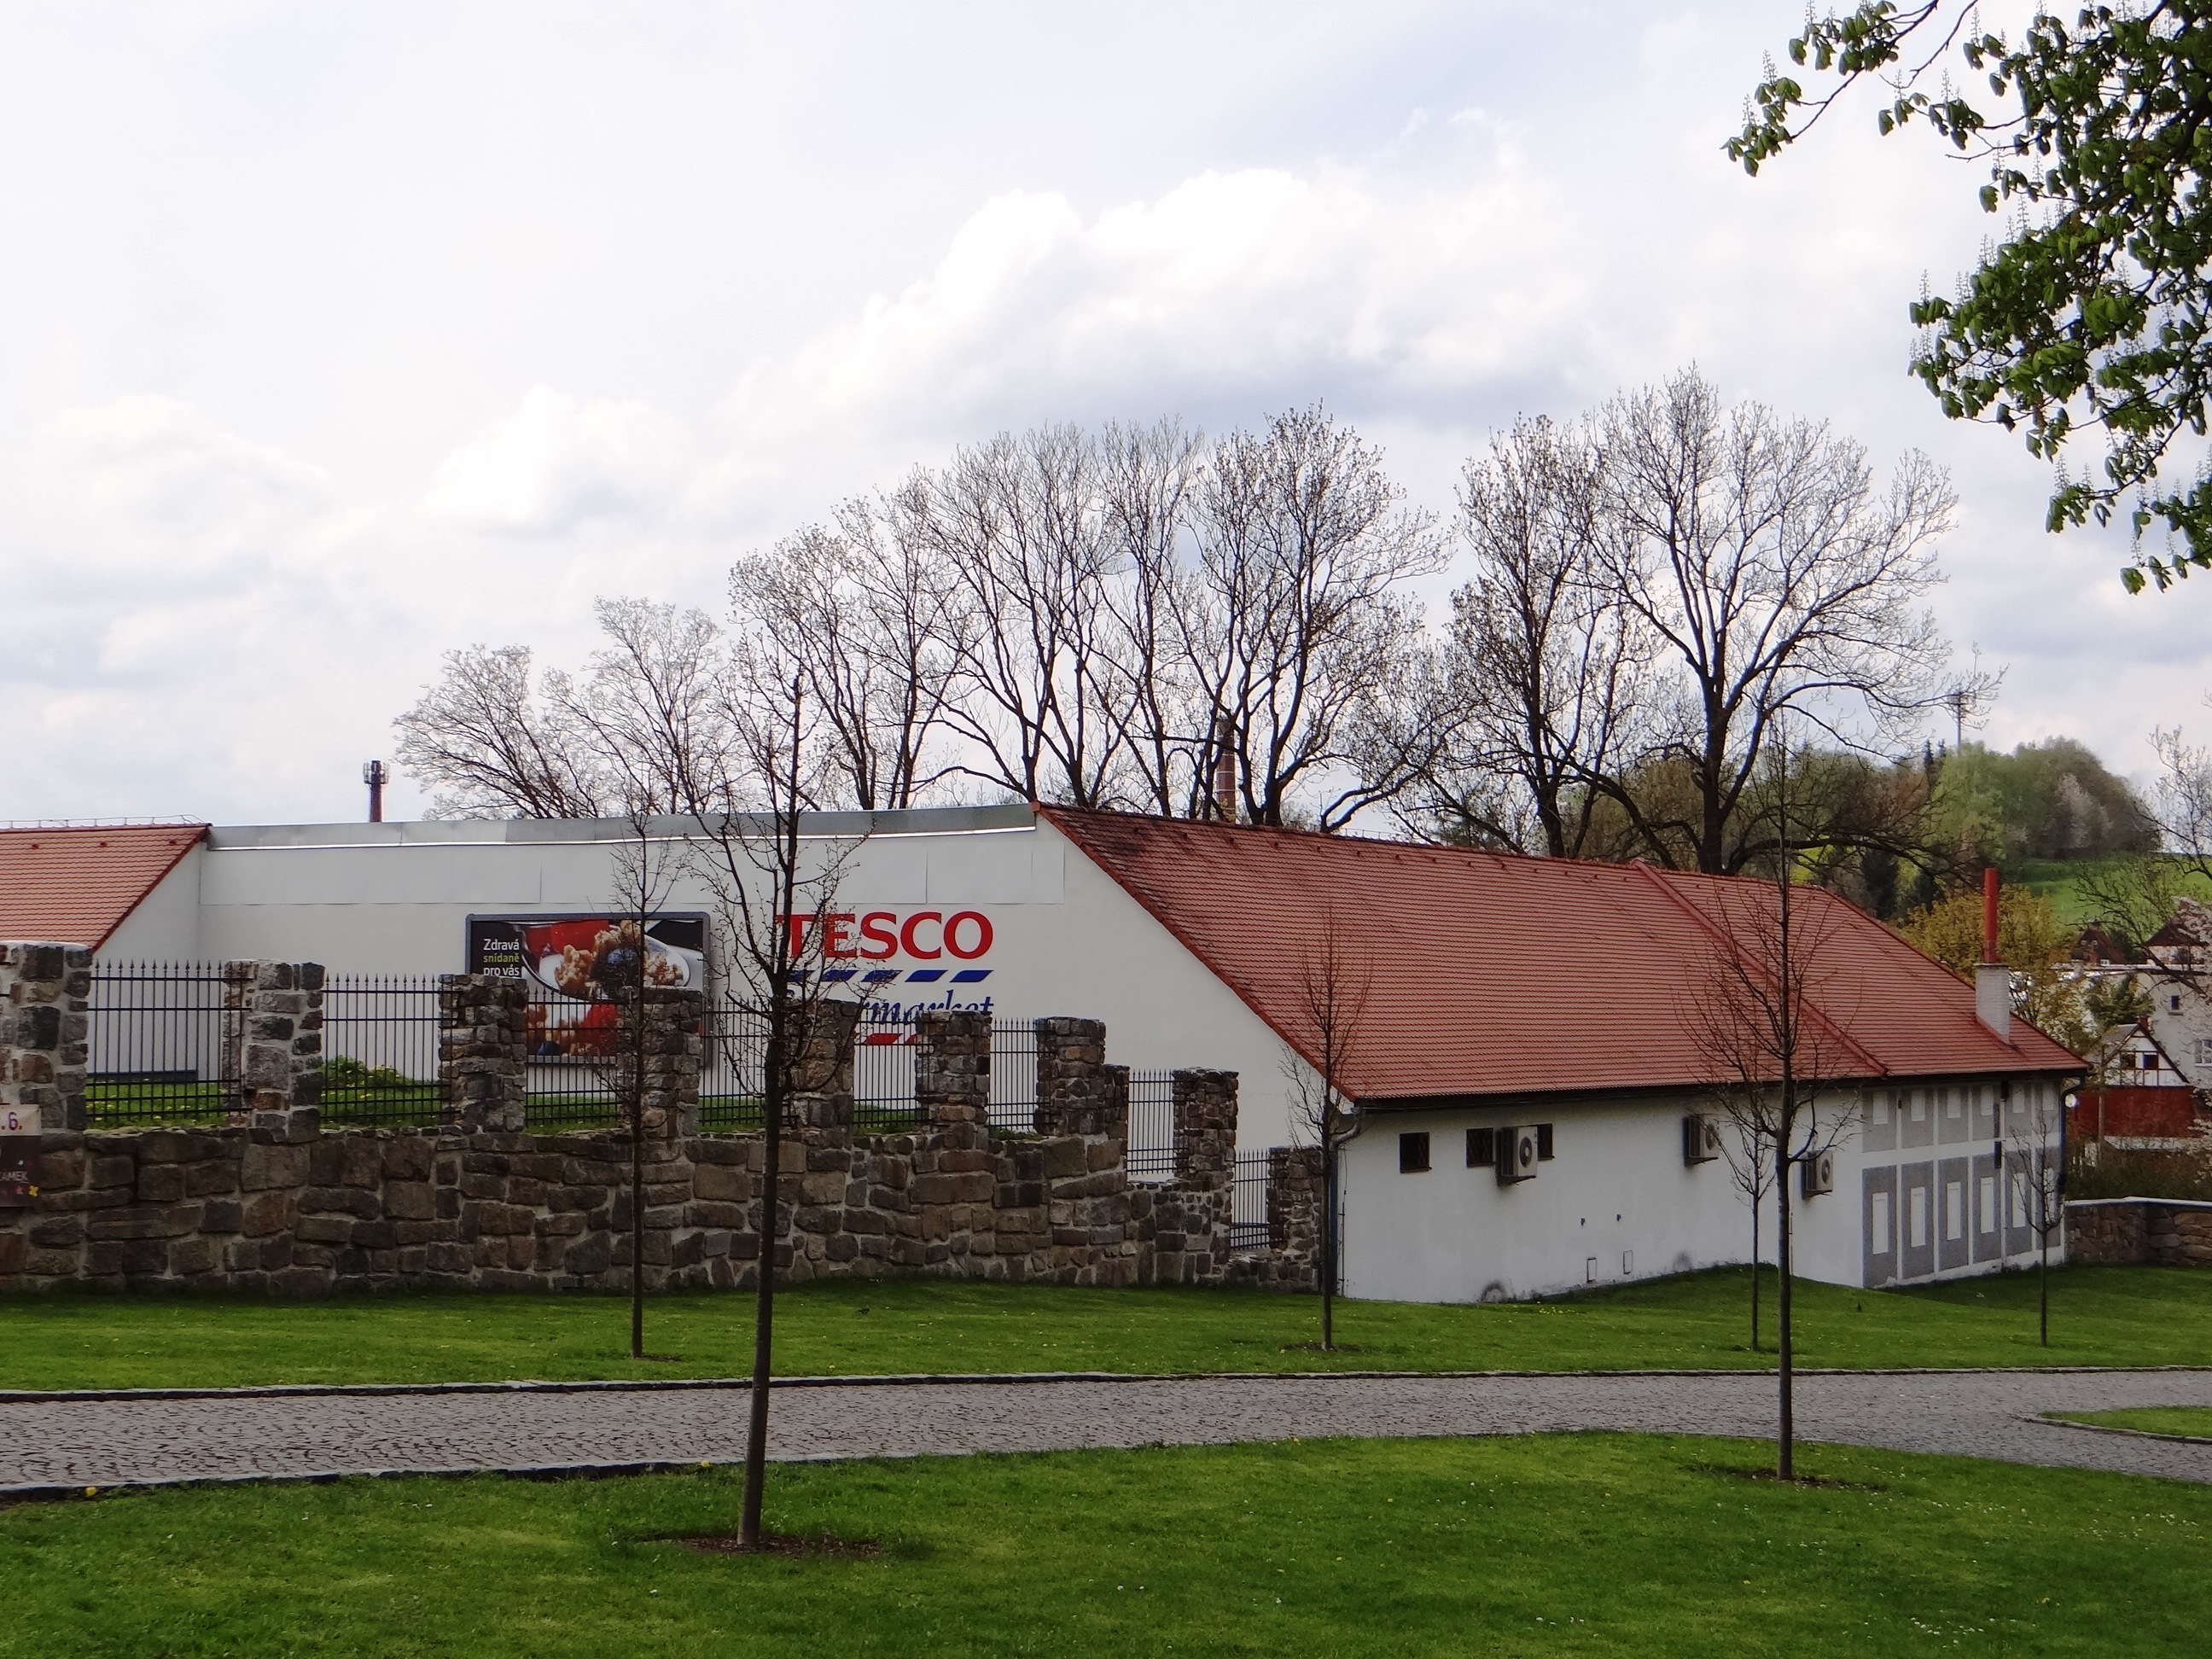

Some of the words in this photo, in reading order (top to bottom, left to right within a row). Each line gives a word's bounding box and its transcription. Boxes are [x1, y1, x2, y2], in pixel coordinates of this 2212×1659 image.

[775, 911, 993, 959] TESCO
[483, 938, 520, 951] Zdravá
[483, 952, 520, 963] snídaně
[483, 967, 501, 976] pro
[502, 963, 520, 976] vás
